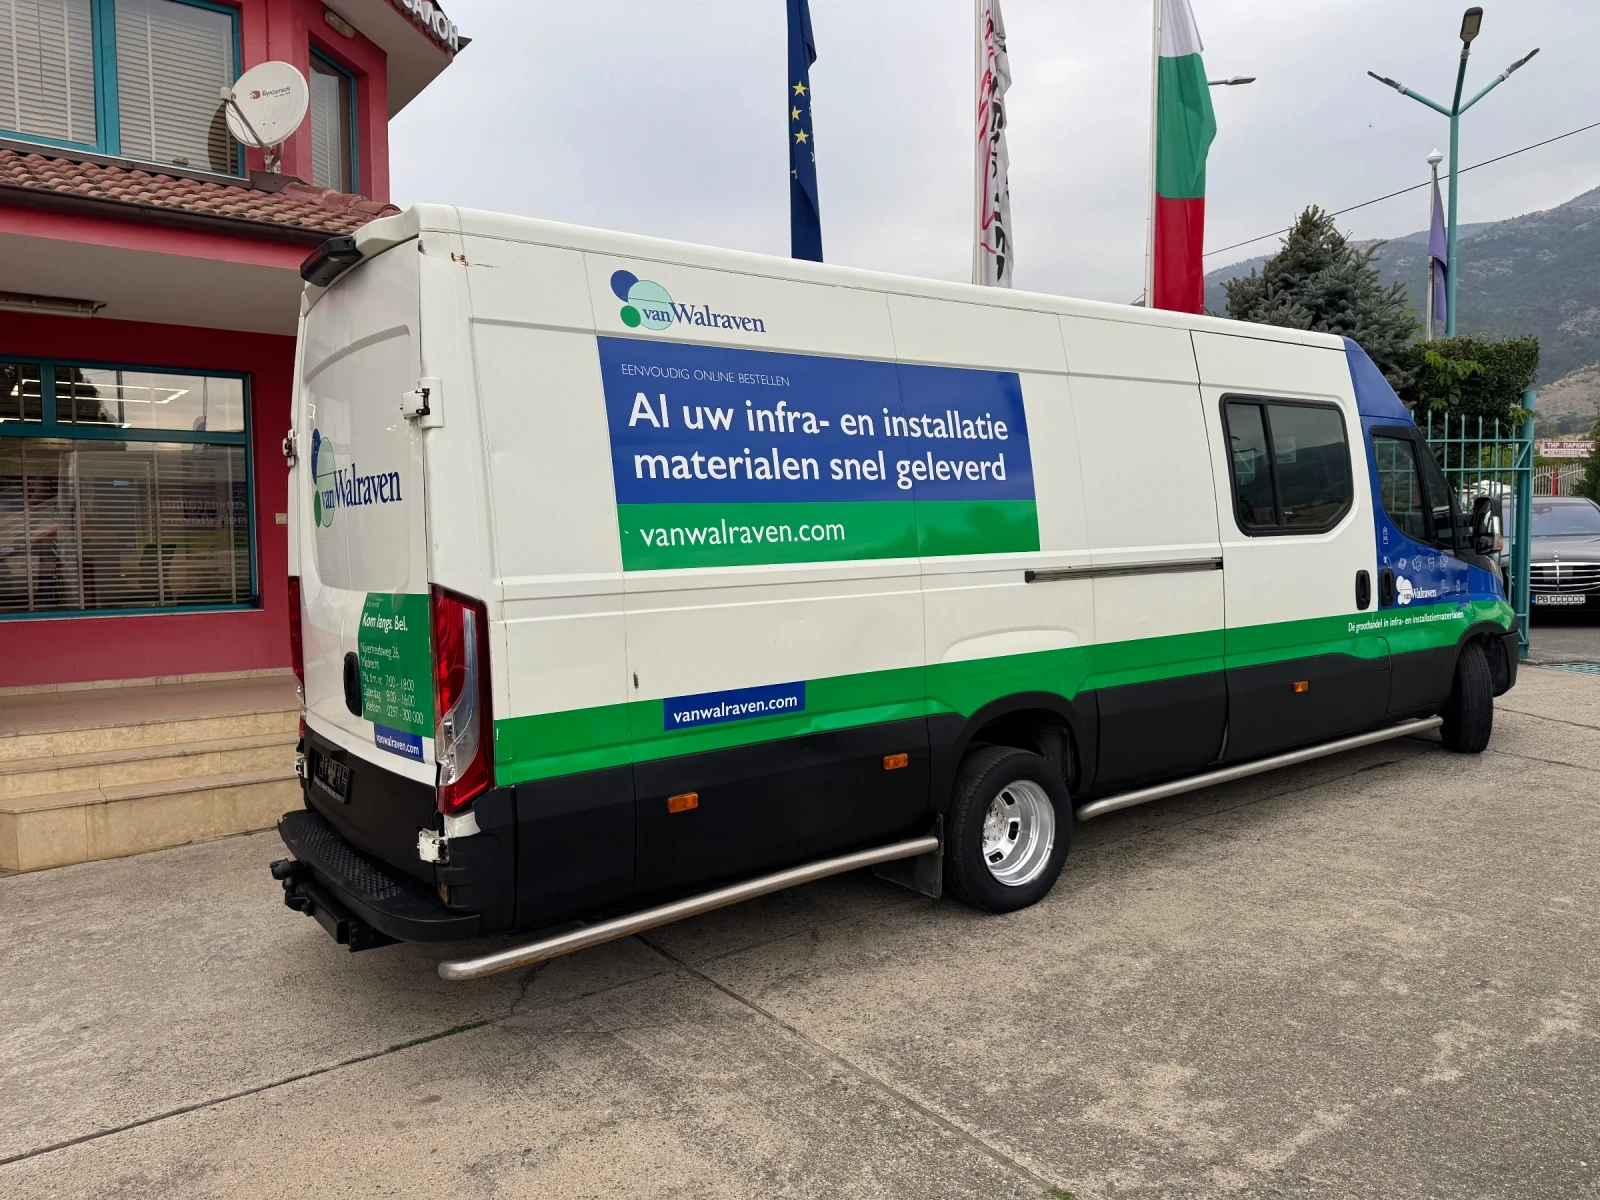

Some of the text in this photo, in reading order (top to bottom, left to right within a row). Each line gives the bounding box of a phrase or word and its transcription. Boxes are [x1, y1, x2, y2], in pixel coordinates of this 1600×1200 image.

[642, 302, 766, 333] van Walraven
[621, 363, 790, 387] EENVOUDIG ONLINE BESTELLEN
[628, 392, 1009, 440] Al uw infra- en installatie
[634, 447, 1007, 490] materialen snel geleverd
[321, 462, 402, 510] van Walraven
[640, 519, 845, 548] vanwalraven.com
[1411, 587, 1437, 600] Walraven
[362, 612, 408, 634] Kom langs. Bel.
[1356, 618, 1382, 634] groothandel
[1383, 618, 1389, 627] in
[1390, 617, 1404, 626] infra-
[1405, 617, 1412, 625] en
[1412, 611, 1464, 624] installatiematerialen
[673, 696, 798, 723] vanwalraven.com
[375, 734, 420, 755] vanwalraven.com
